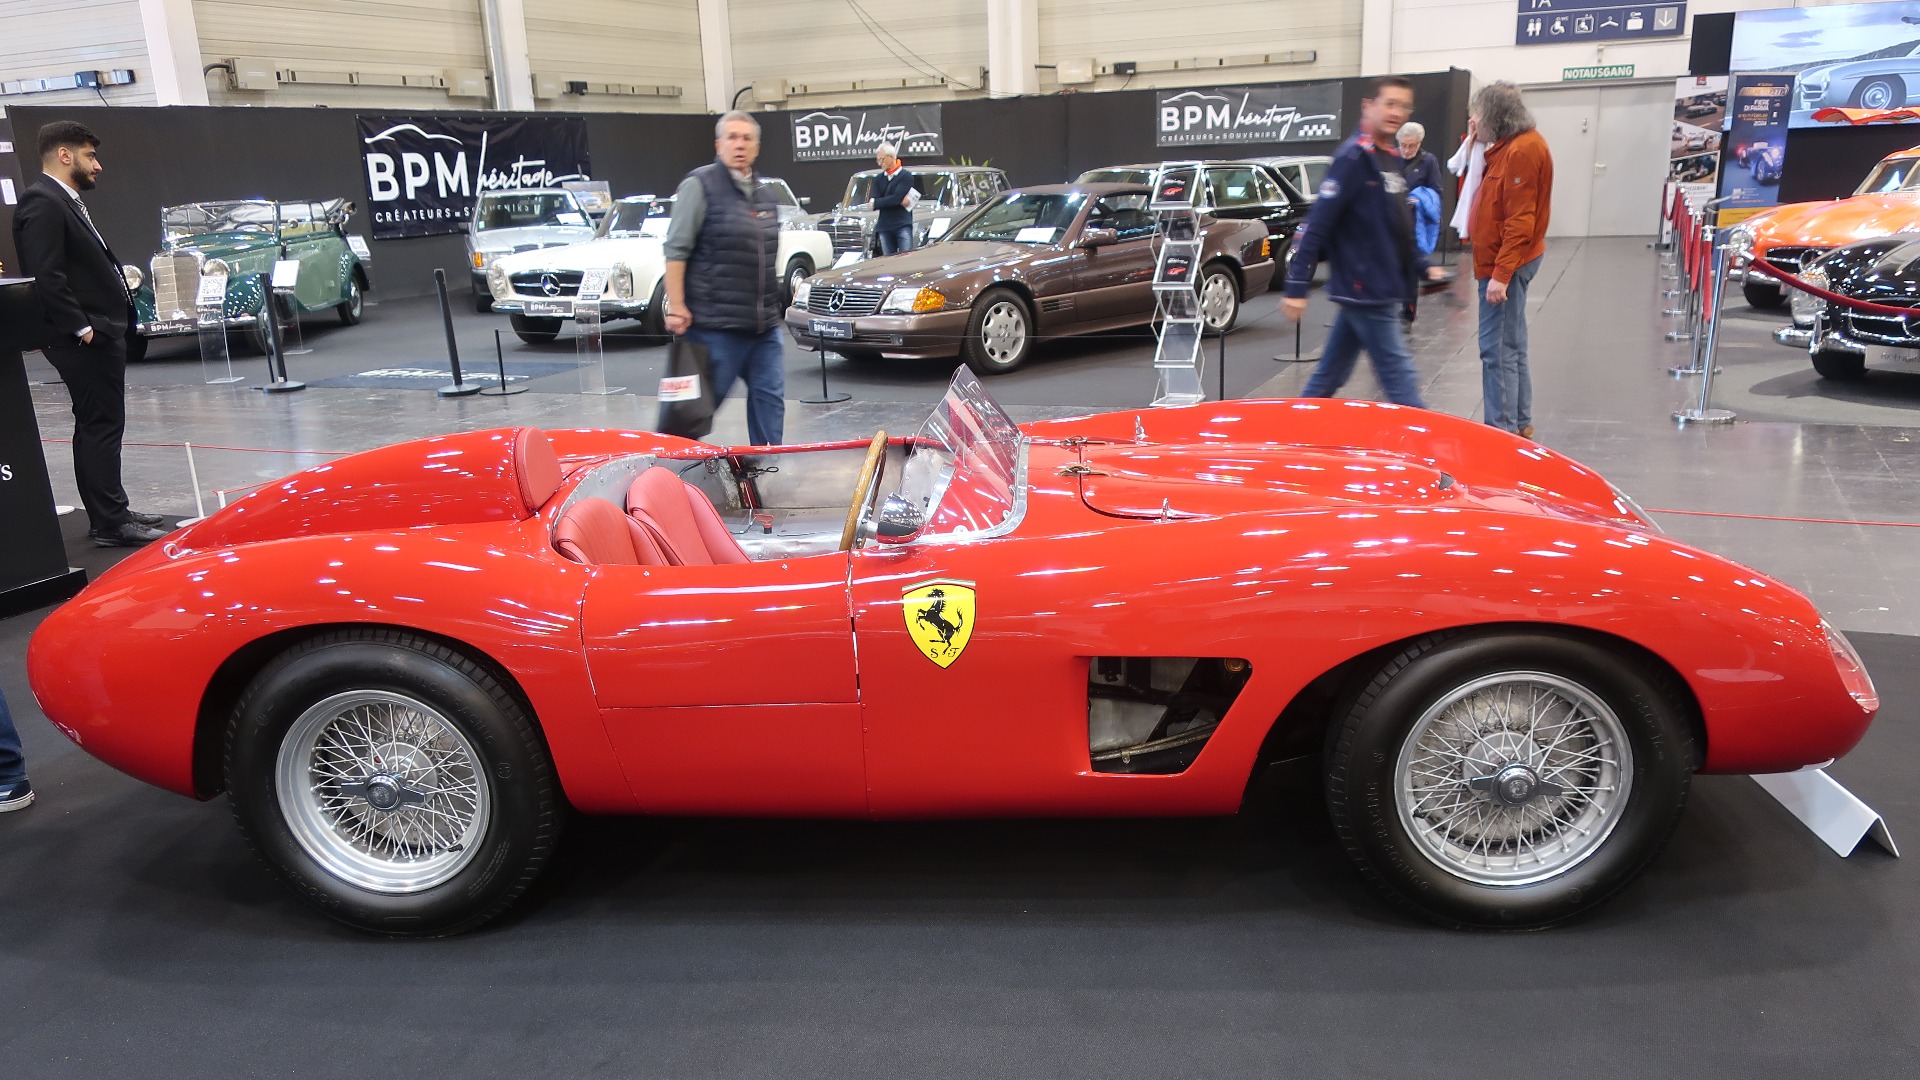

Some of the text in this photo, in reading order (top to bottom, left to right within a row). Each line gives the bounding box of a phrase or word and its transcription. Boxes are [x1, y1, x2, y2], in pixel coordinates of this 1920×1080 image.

[1564, 65, 1633, 79] NOTAUSGANG
[1161, 103, 1230, 132] BPM
[795, 122, 853, 149] BPM
[1161, 132, 1213, 143] CRÉATEURS
[1222, 131, 1277, 140] SOUVENIRS
[366, 151, 471, 202] BPM
[375, 205, 451, 224] CRÉATEURS
[151, 323, 169, 332] BPM
[930, 648, 939, 659] S
